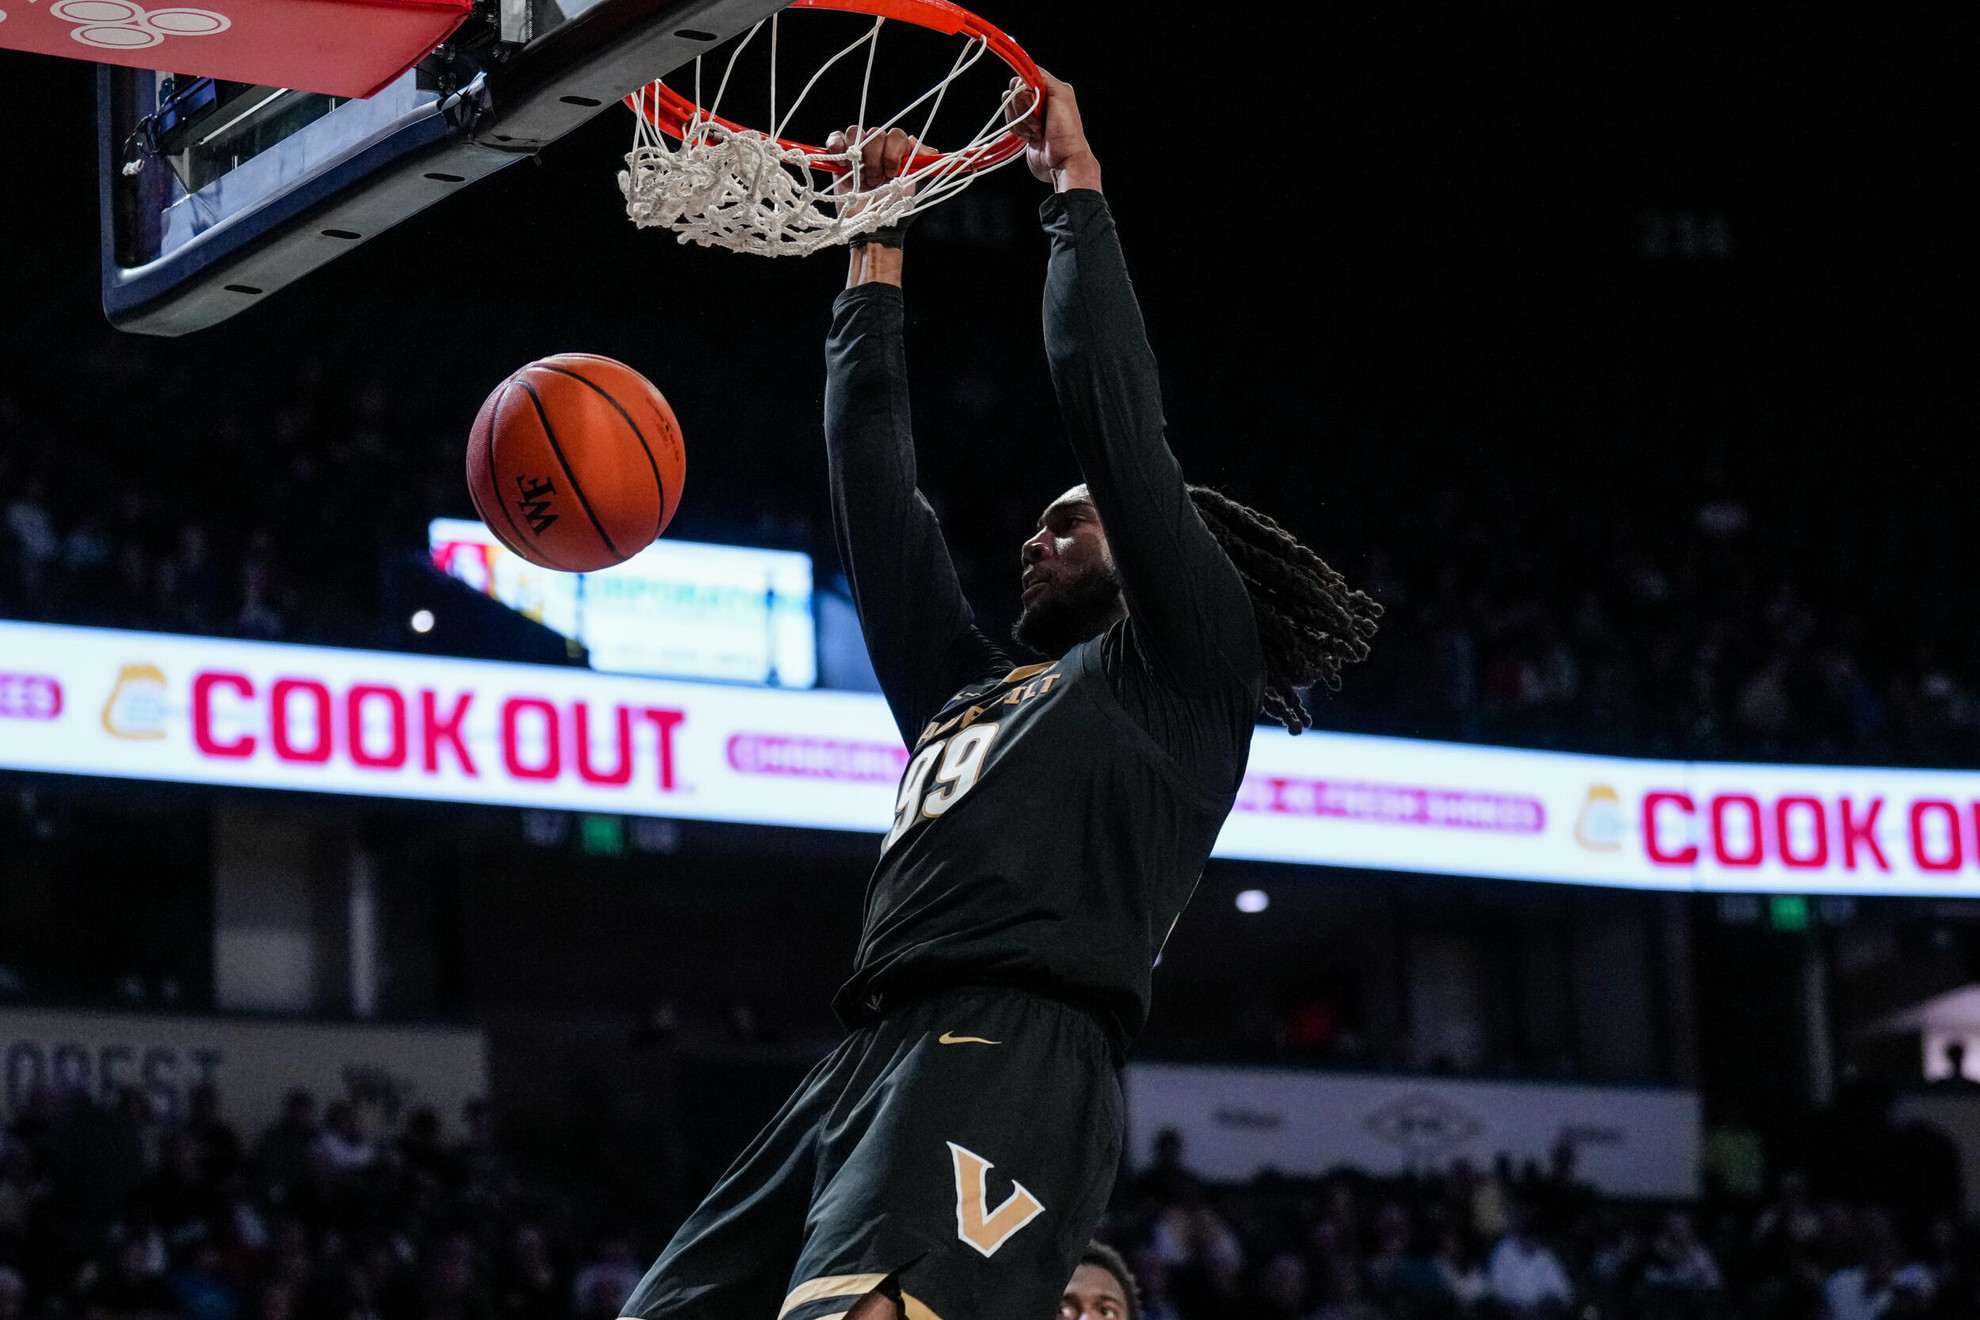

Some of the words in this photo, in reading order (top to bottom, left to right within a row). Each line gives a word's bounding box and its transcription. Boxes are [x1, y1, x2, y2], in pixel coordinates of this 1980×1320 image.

[515, 474, 559, 537] WF
[192, 671, 478, 778] COOK
[502, 696, 686, 792] OUT
[887, 722, 1000, 851] 99
[1643, 791, 1891, 872] COOK
[1909, 799, 1980, 872] O
[946, 1141, 1046, 1258] V
